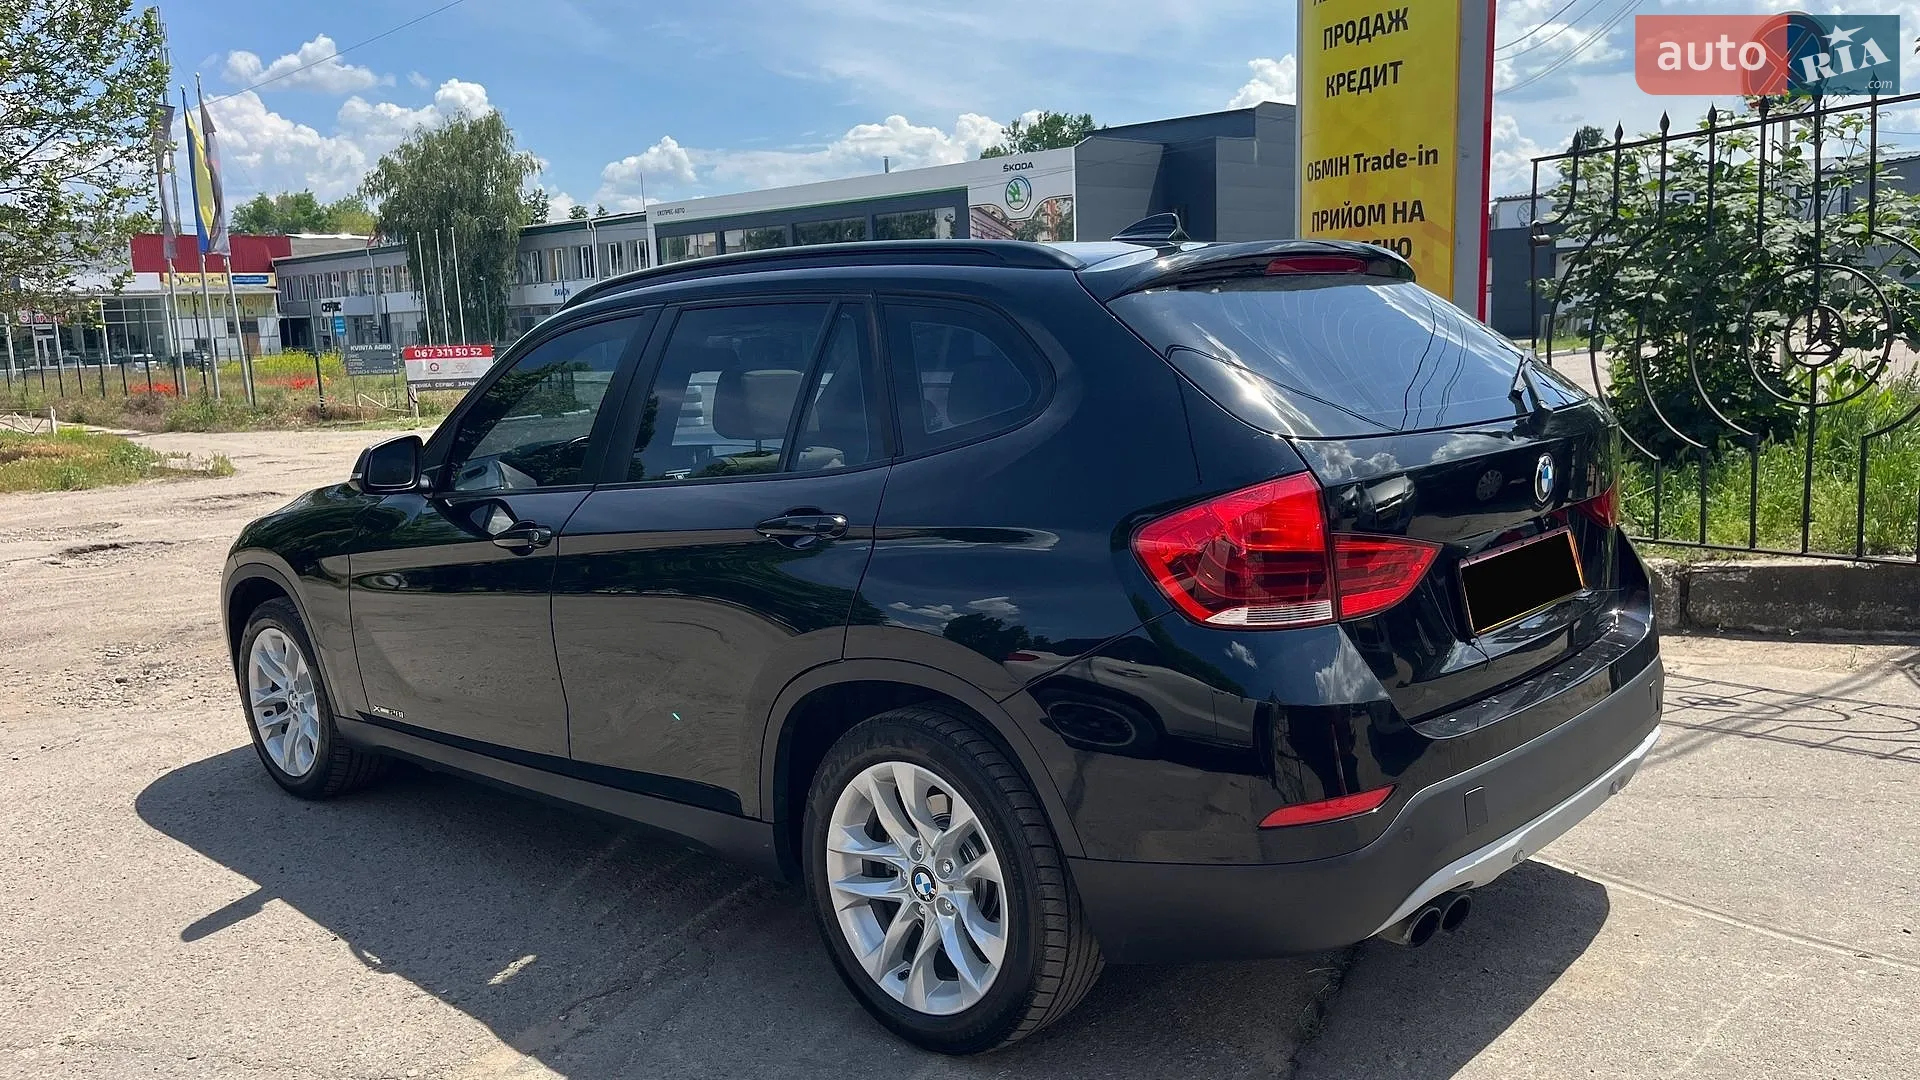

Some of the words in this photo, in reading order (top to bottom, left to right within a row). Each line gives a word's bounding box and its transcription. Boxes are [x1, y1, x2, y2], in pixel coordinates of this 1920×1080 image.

[1323, 7, 1409, 50] ПРОДАЖ
[1326, 60, 1403, 98] КРЕДИТ
[1003, 161, 1034, 173] ŠKODA
[1307, 159, 1350, 182] ОБМІН
[1354, 144, 1439, 174] Trade-in
[1311, 200, 1386, 233] ПРИЙОМ
[1392, 199, 1425, 225] НА
[414, 349, 434, 358] 067
[436, 348, 453, 357] 311
[455, 348, 468, 357] 50
[470, 347, 483, 356] 52
